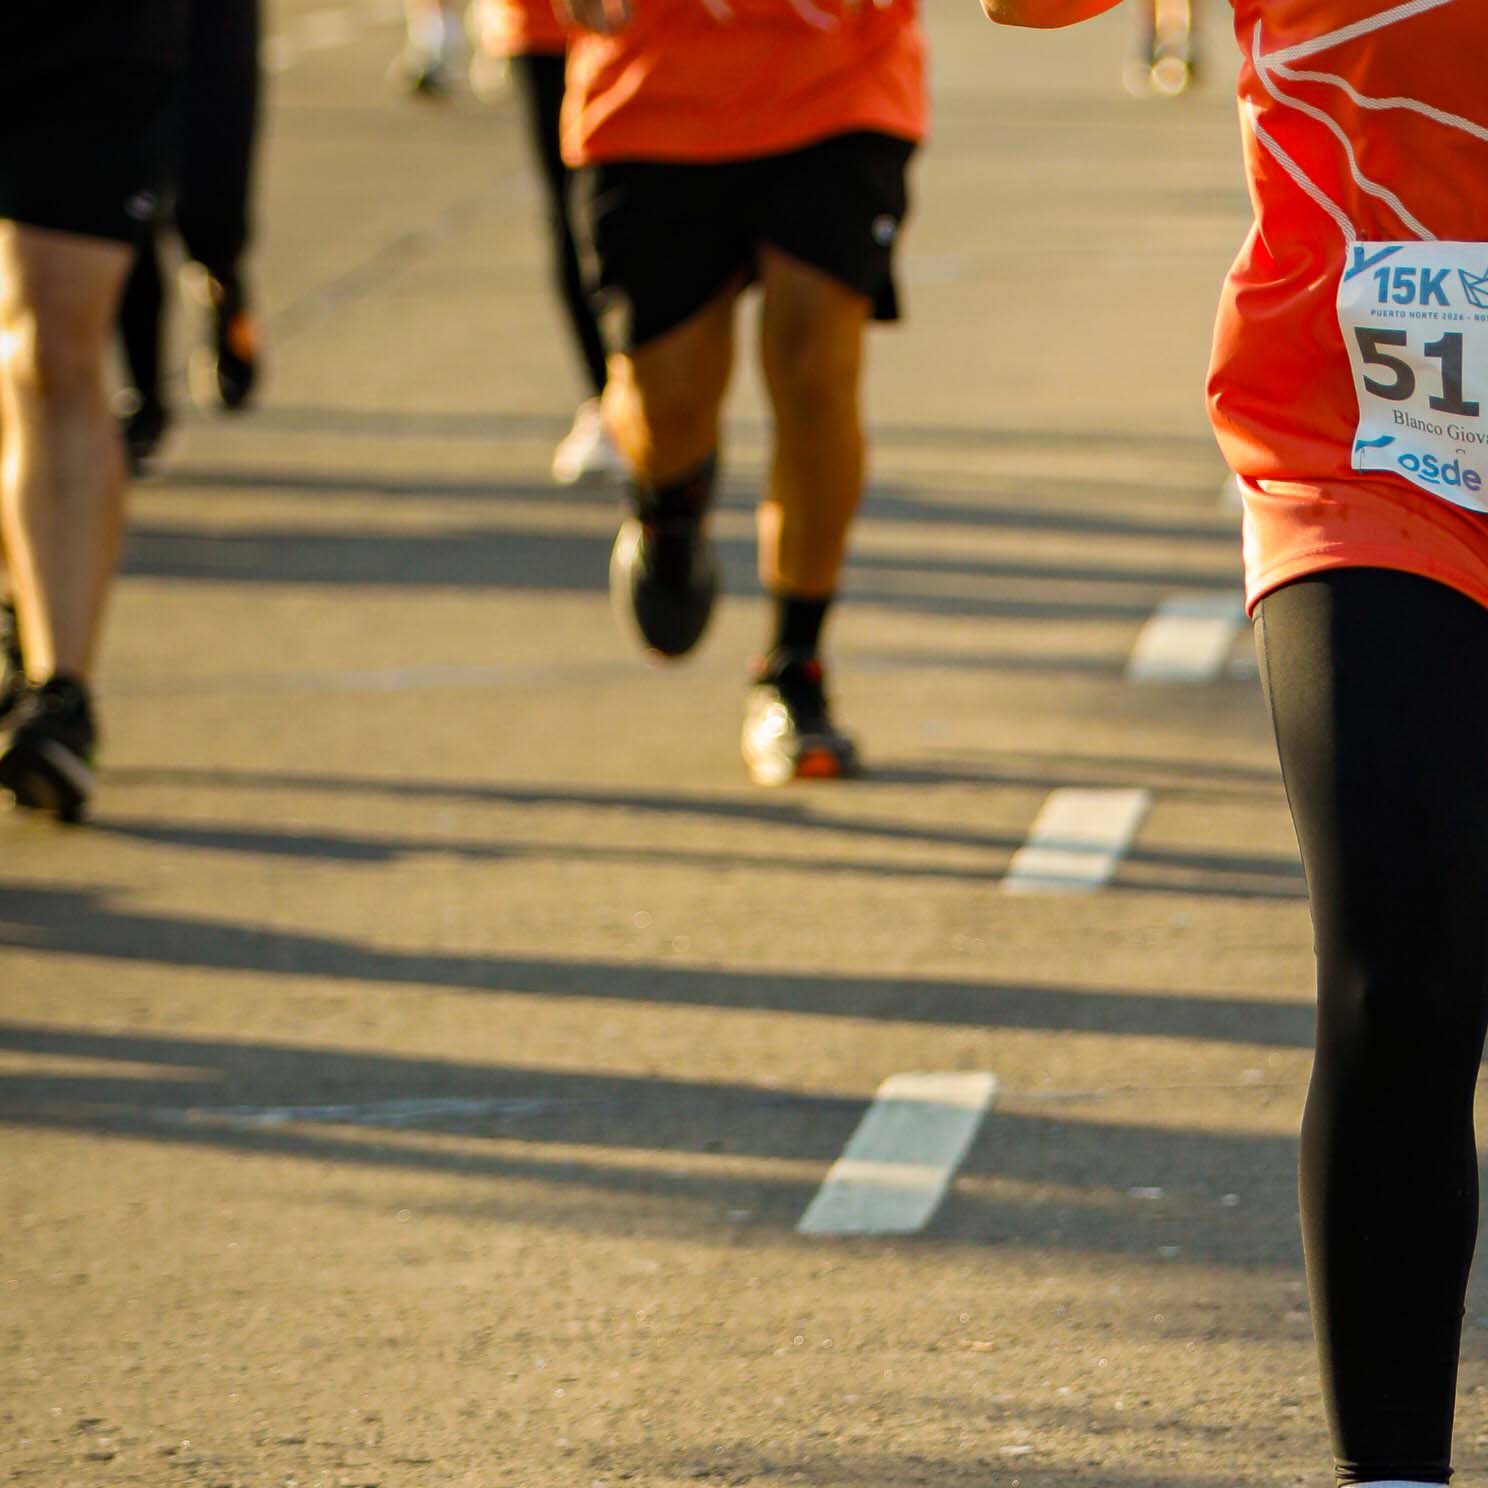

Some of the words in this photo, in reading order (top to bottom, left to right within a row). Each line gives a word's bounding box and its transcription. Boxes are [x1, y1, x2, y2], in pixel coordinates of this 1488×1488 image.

[1373, 265, 1451, 306] 15K
[1370, 309, 1406, 318] PUERTO
[1408, 312, 1439, 320] NORTE
[1392, 409, 1443, 437] Blanco
